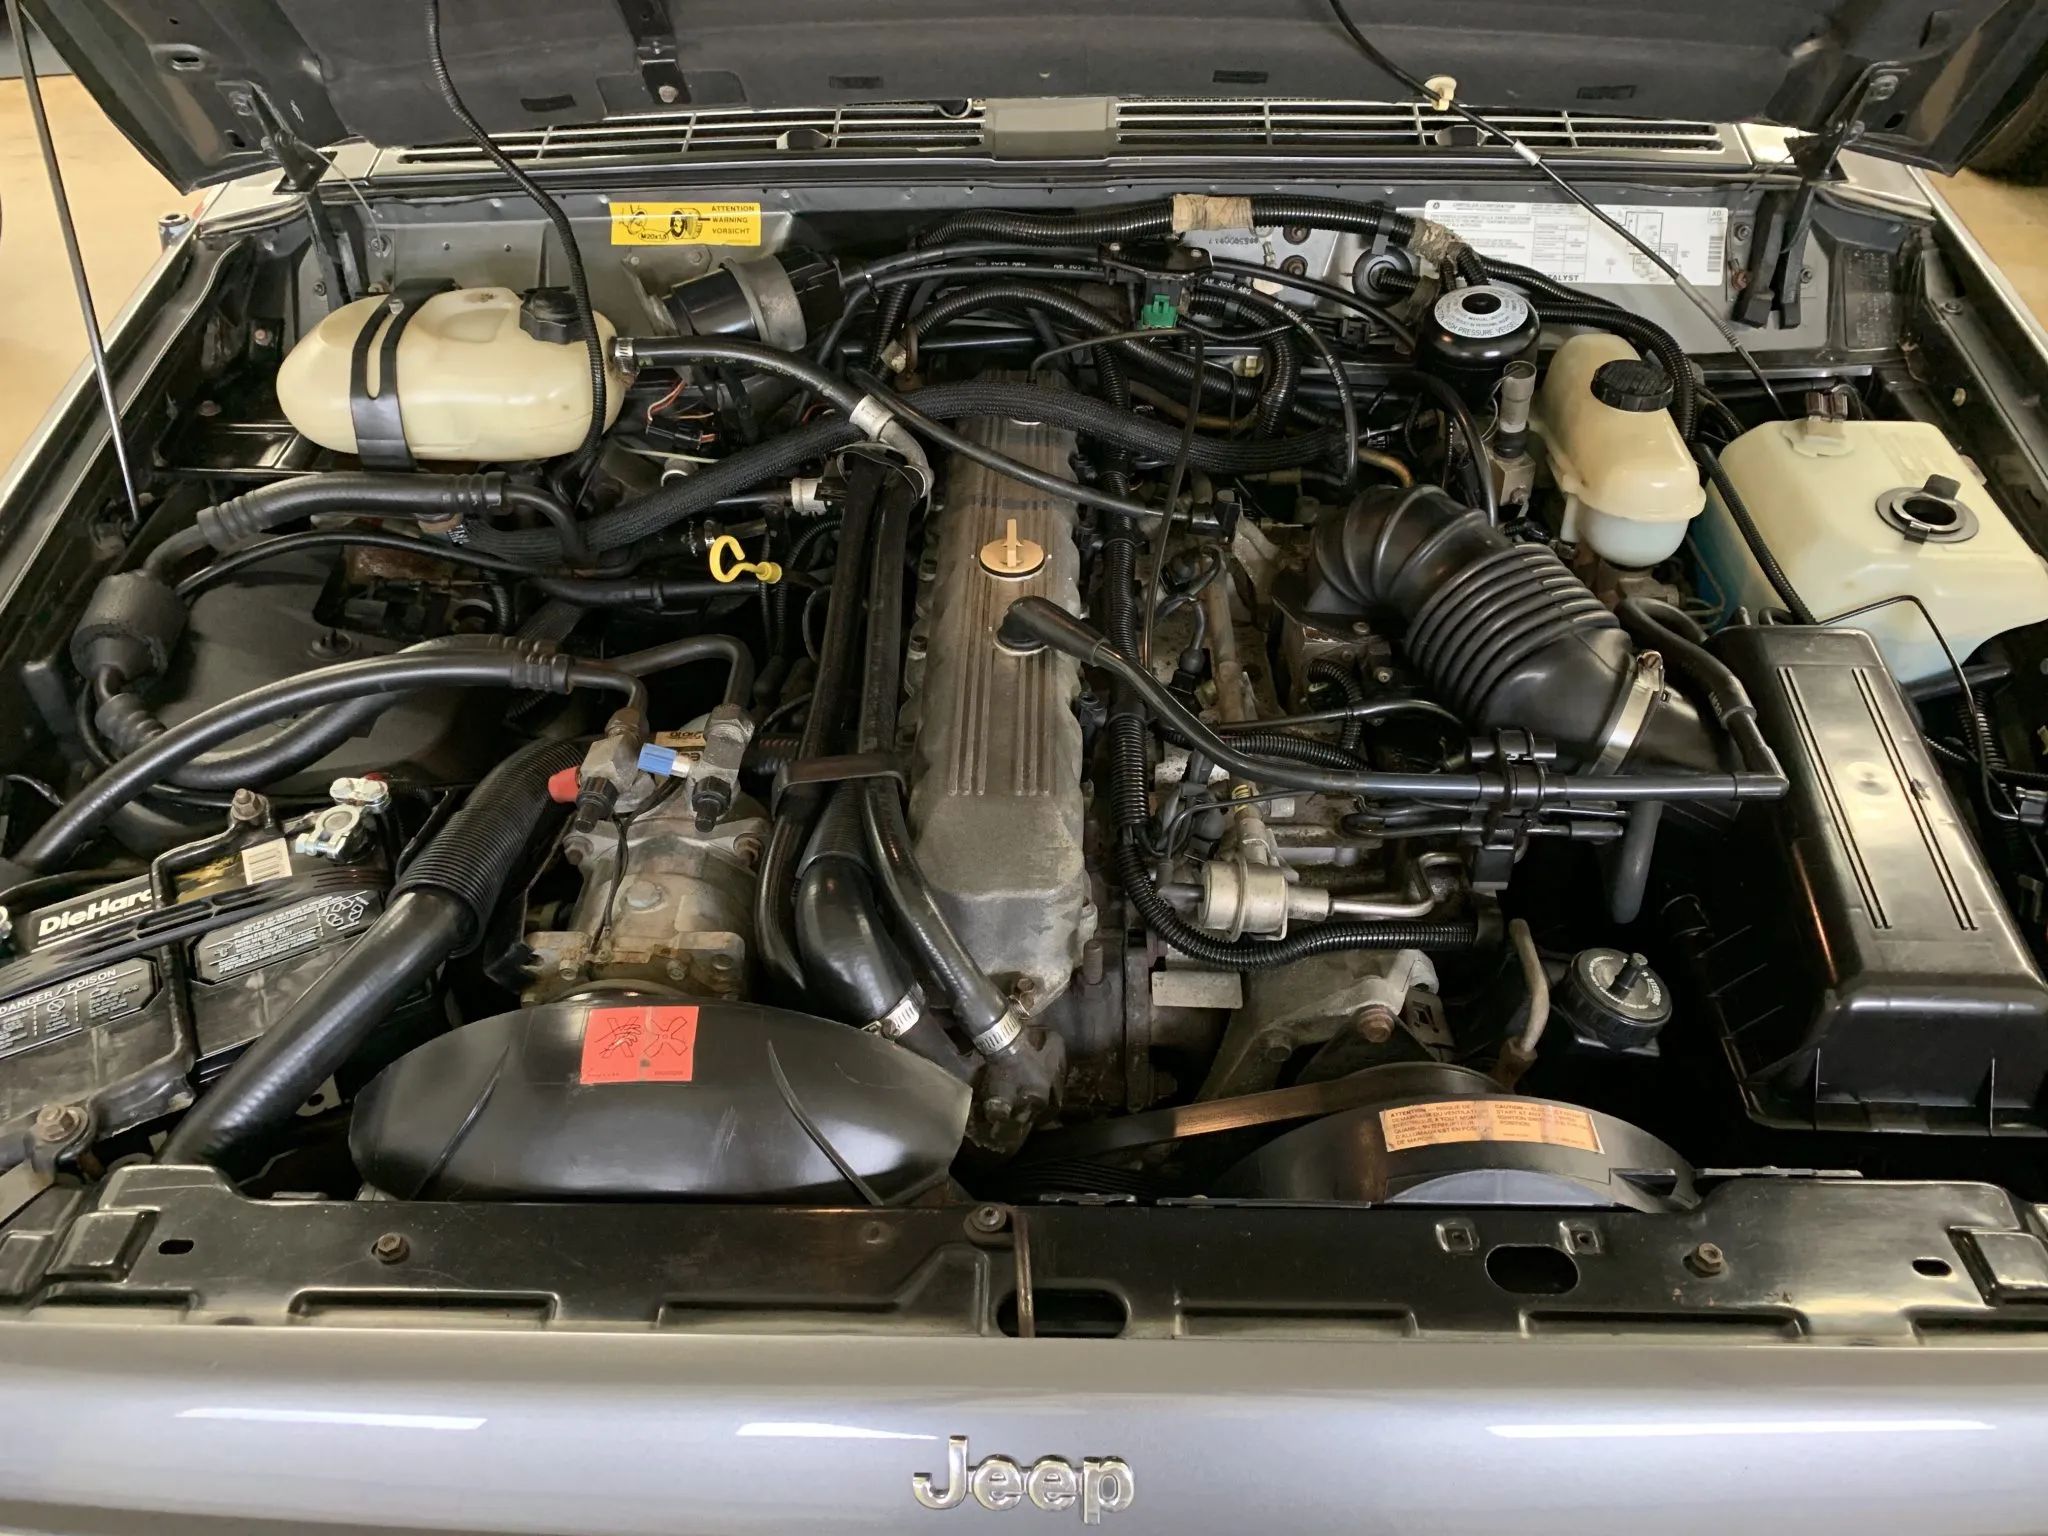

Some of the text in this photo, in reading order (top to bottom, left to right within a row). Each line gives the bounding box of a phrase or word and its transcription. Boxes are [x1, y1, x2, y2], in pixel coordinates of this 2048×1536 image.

[1548, 274, 1580, 282] TALYST
[1458, 326, 1494, 337] PRESSURE
[0, 990, 54, 1014] DANGER
[67, 968, 117, 993] POISON
[1390, 1108, 1426, 1117] ATTENTION
[912, 1434, 1135, 1525] Jeep
